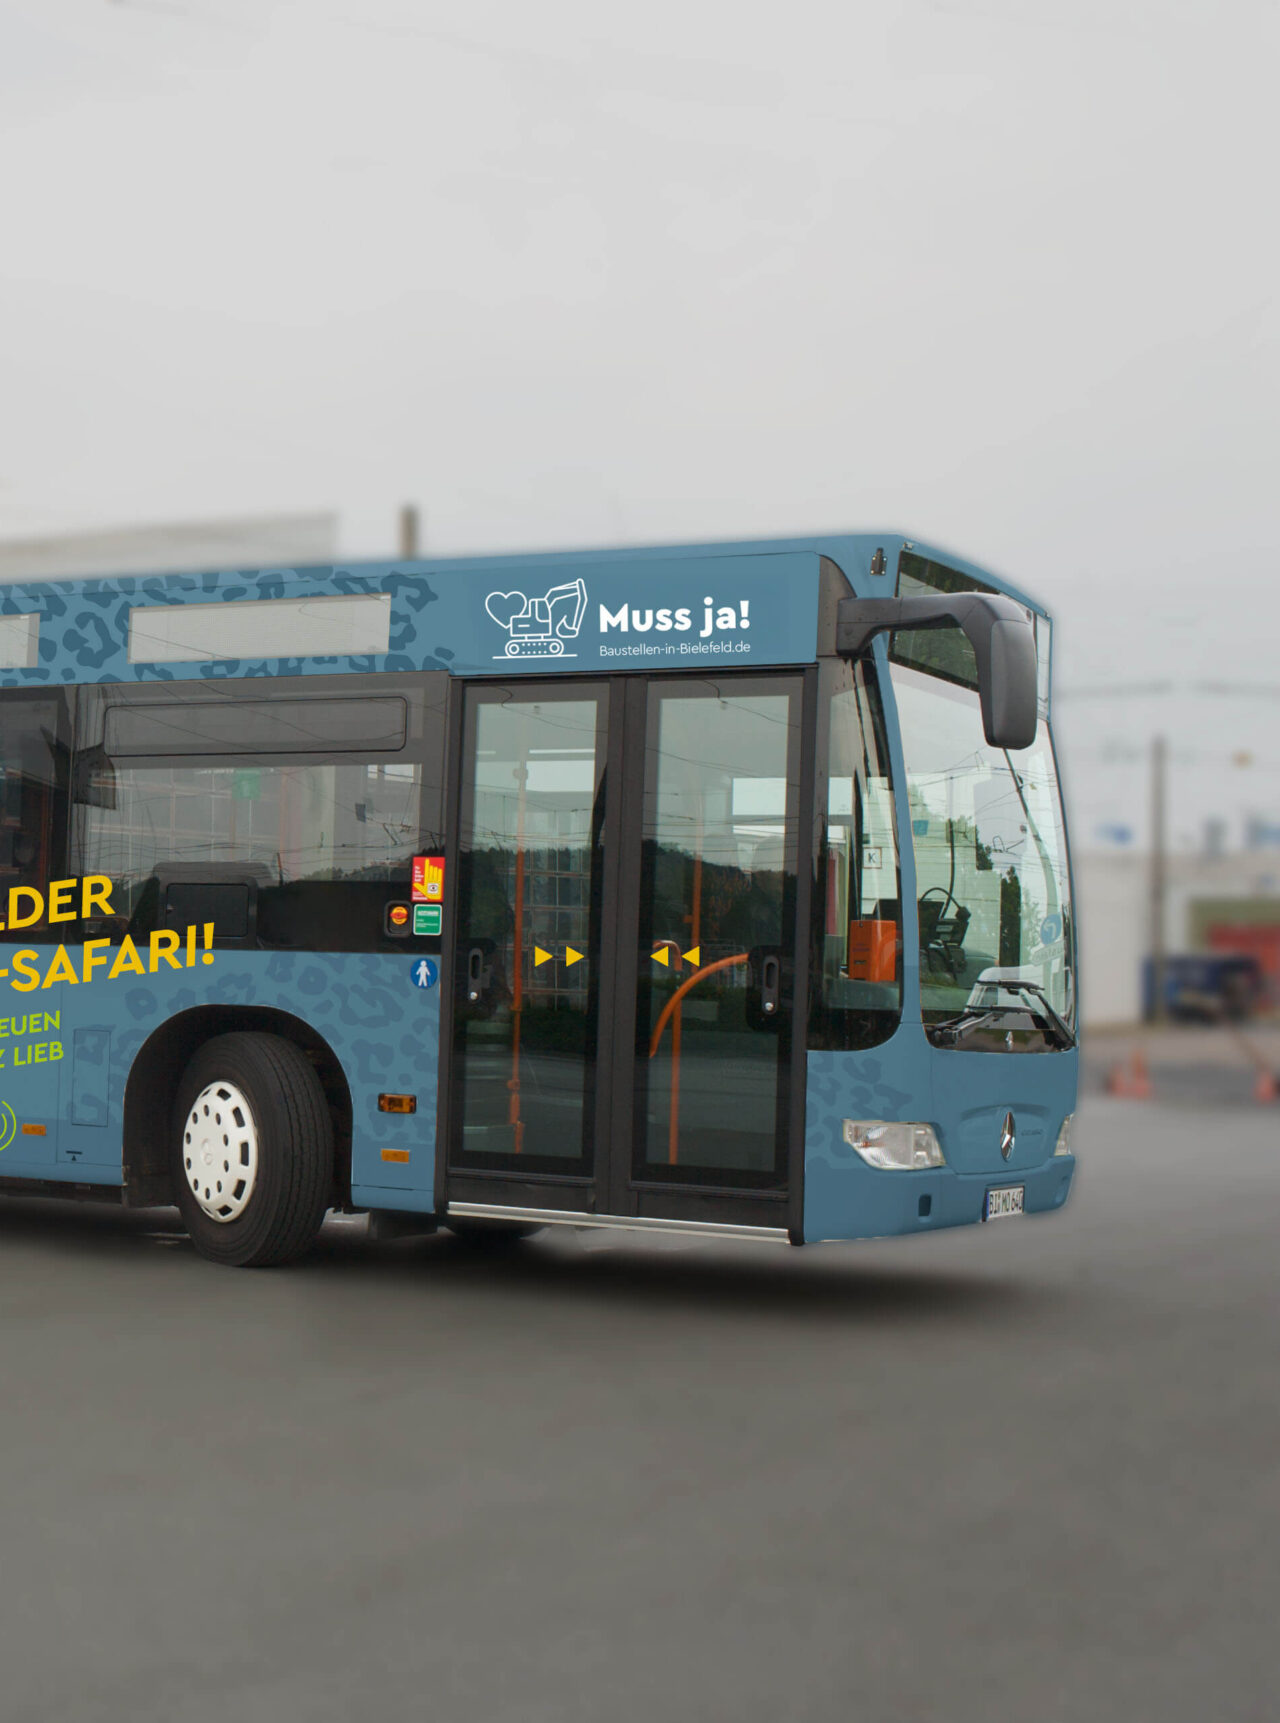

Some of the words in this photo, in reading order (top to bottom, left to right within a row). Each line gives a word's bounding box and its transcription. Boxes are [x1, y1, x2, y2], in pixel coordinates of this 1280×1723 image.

[598, 602, 693, 634] Muss
[699, 595, 751, 639] ja!
[599, 639, 752, 657] Baustellen-in-Bielefeld.de
[13, 1040, 64, 1067] LIEB
